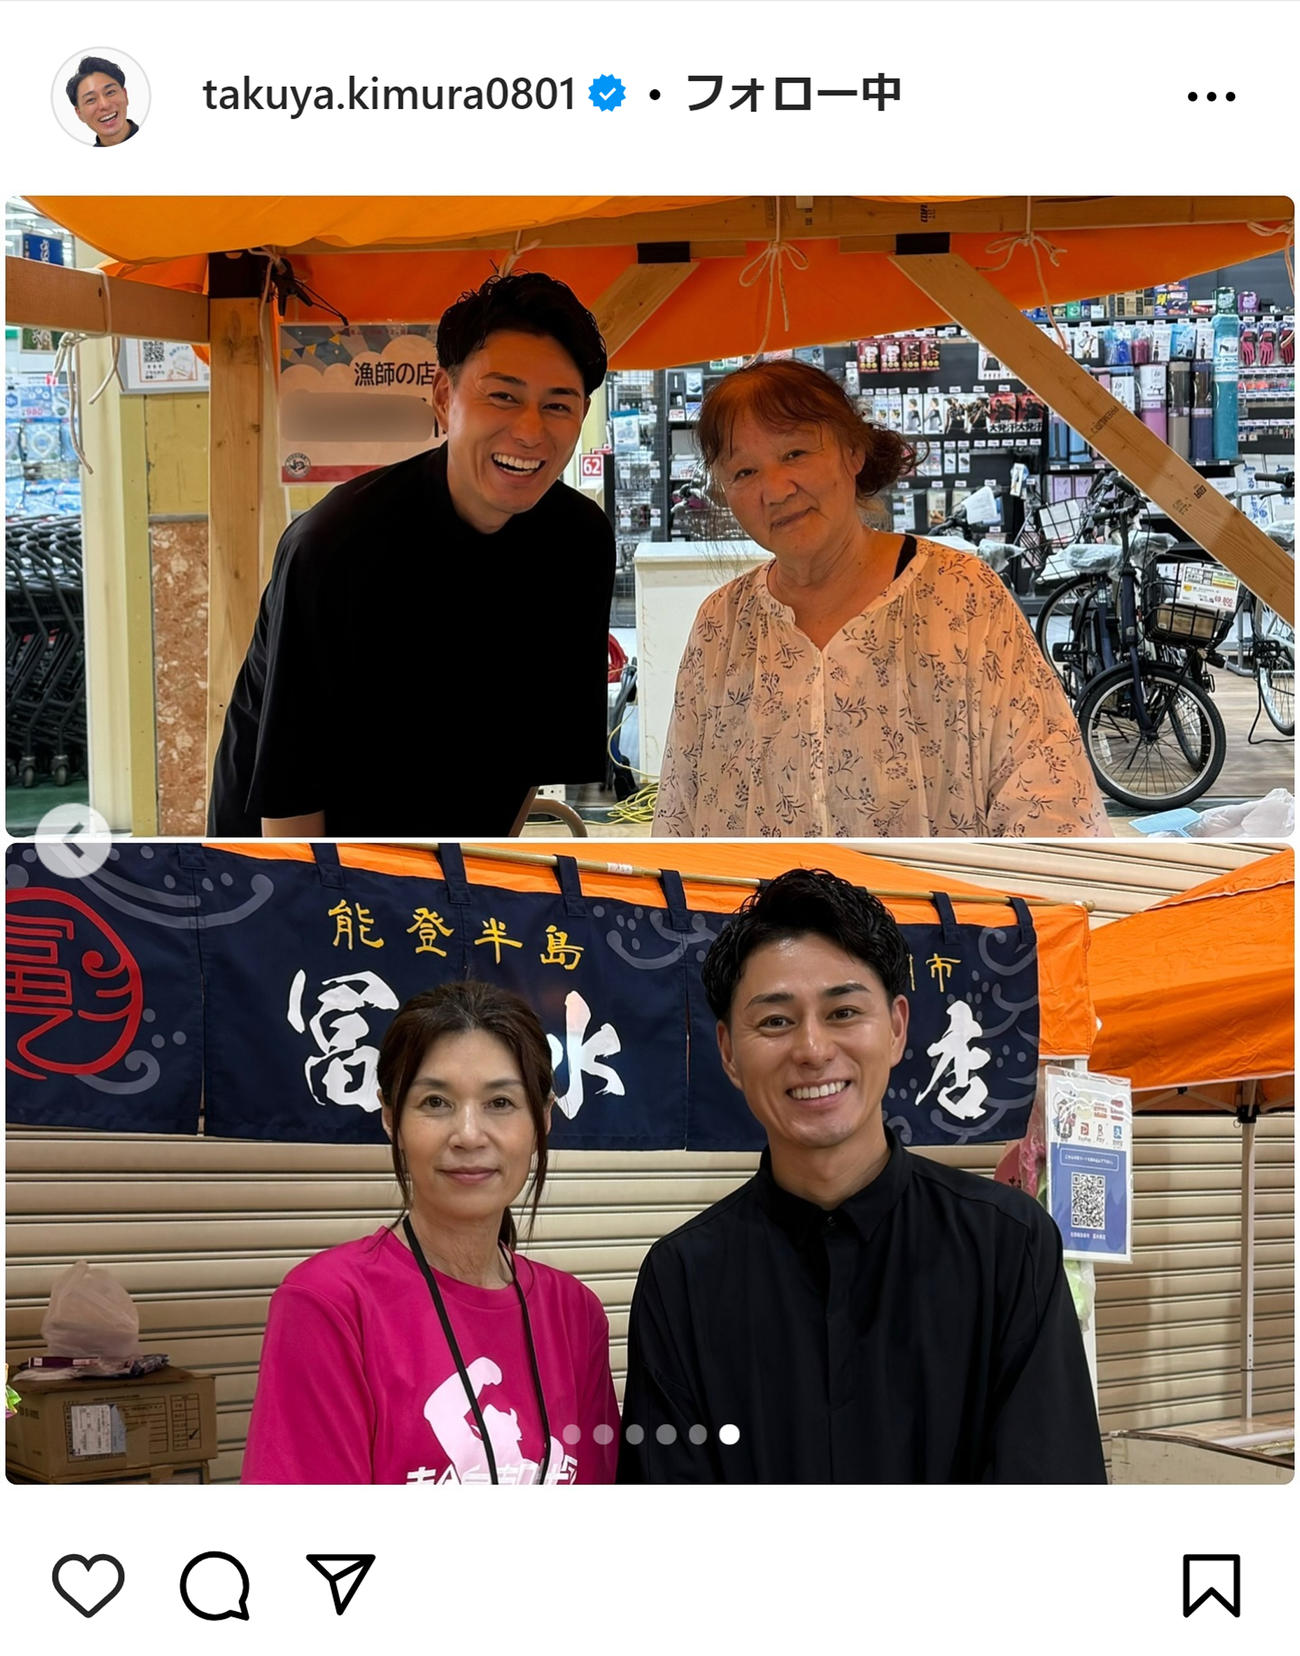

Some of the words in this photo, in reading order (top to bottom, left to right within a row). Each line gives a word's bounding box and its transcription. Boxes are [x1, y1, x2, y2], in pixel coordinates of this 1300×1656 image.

[354, 361, 437, 387] 漁師の店
[583, 458, 601, 475] 62
[328, 899, 584, 970] 能登半島
